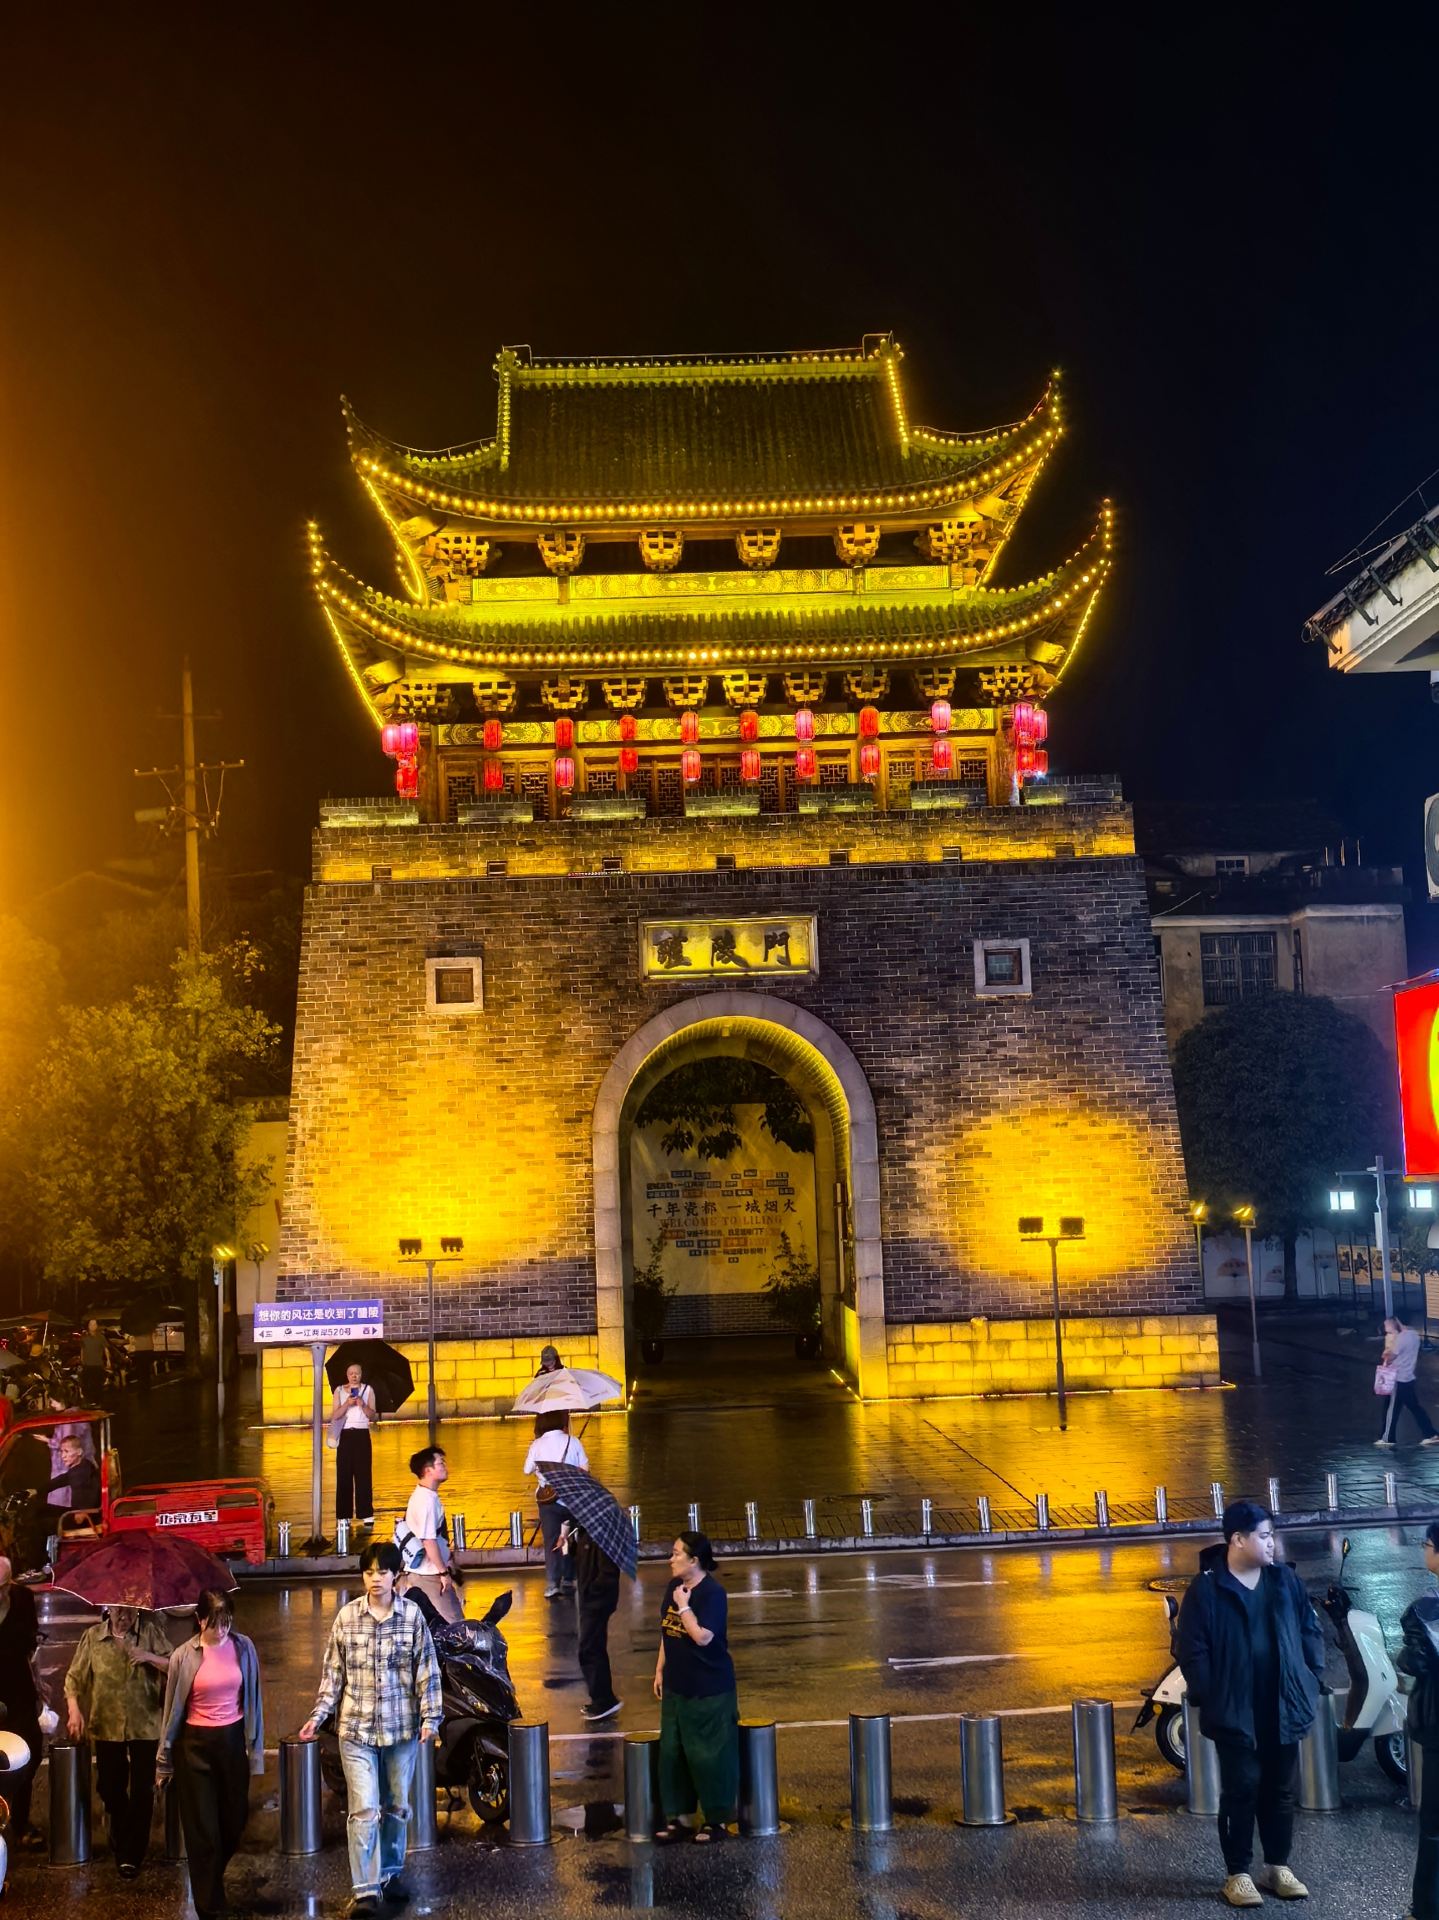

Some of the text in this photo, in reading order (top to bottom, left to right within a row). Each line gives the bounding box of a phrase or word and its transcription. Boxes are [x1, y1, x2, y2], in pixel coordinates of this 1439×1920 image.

[647, 1199, 797, 1218] 千年瓷都 一城烟火
[660, 1215, 782, 1227] WELCOME TO LILING
[258, 1306, 379, 1322] 想你的风还是吹到了醴陵
